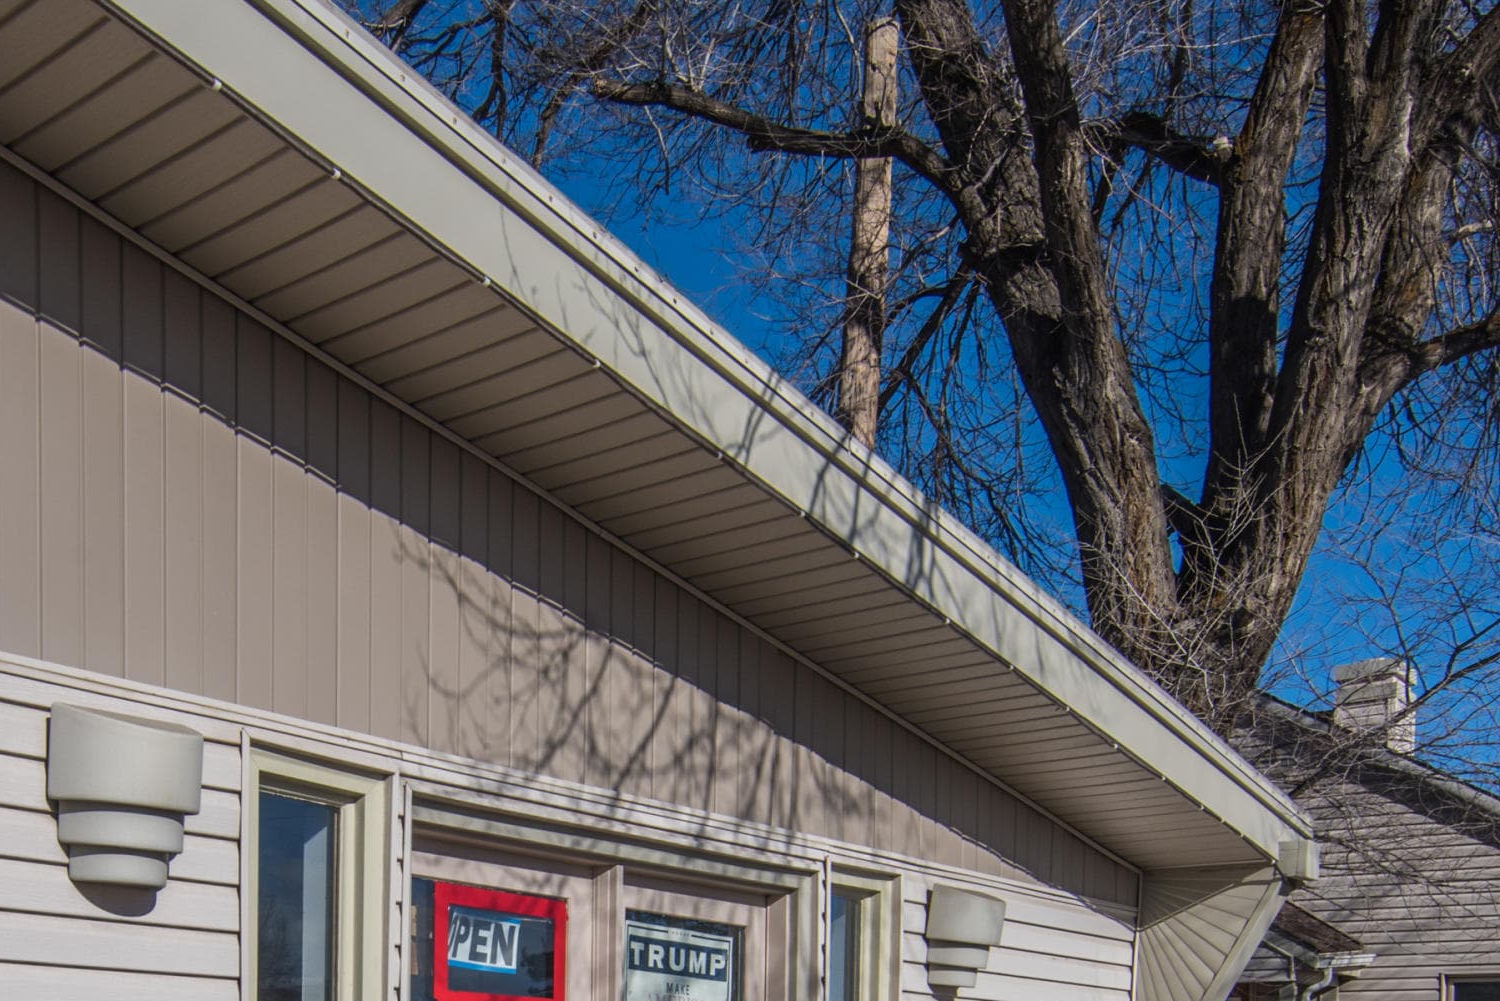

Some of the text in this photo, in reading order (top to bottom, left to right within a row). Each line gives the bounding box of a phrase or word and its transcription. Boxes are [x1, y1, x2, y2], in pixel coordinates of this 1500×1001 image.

[450, 915, 516, 966] PEN
[630, 941, 726, 976] TRUMP
[666, 982, 690, 995] MAKE
